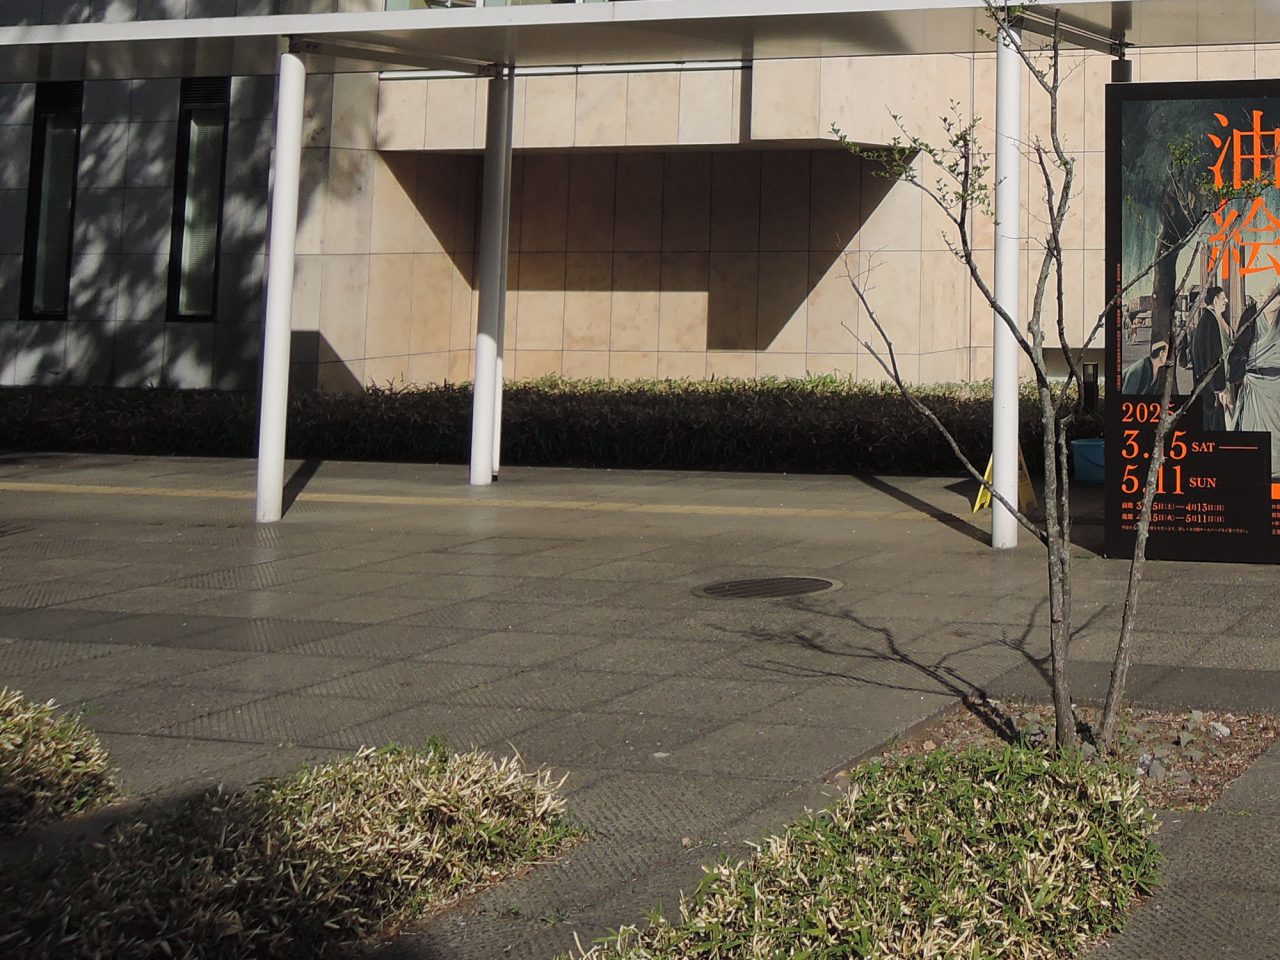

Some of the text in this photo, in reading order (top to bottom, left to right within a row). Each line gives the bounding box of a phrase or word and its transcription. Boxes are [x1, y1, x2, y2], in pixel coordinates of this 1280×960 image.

[1121, 429, 1216, 460] 3.5 SAT
[1189, 477, 1217, 488] SUN
